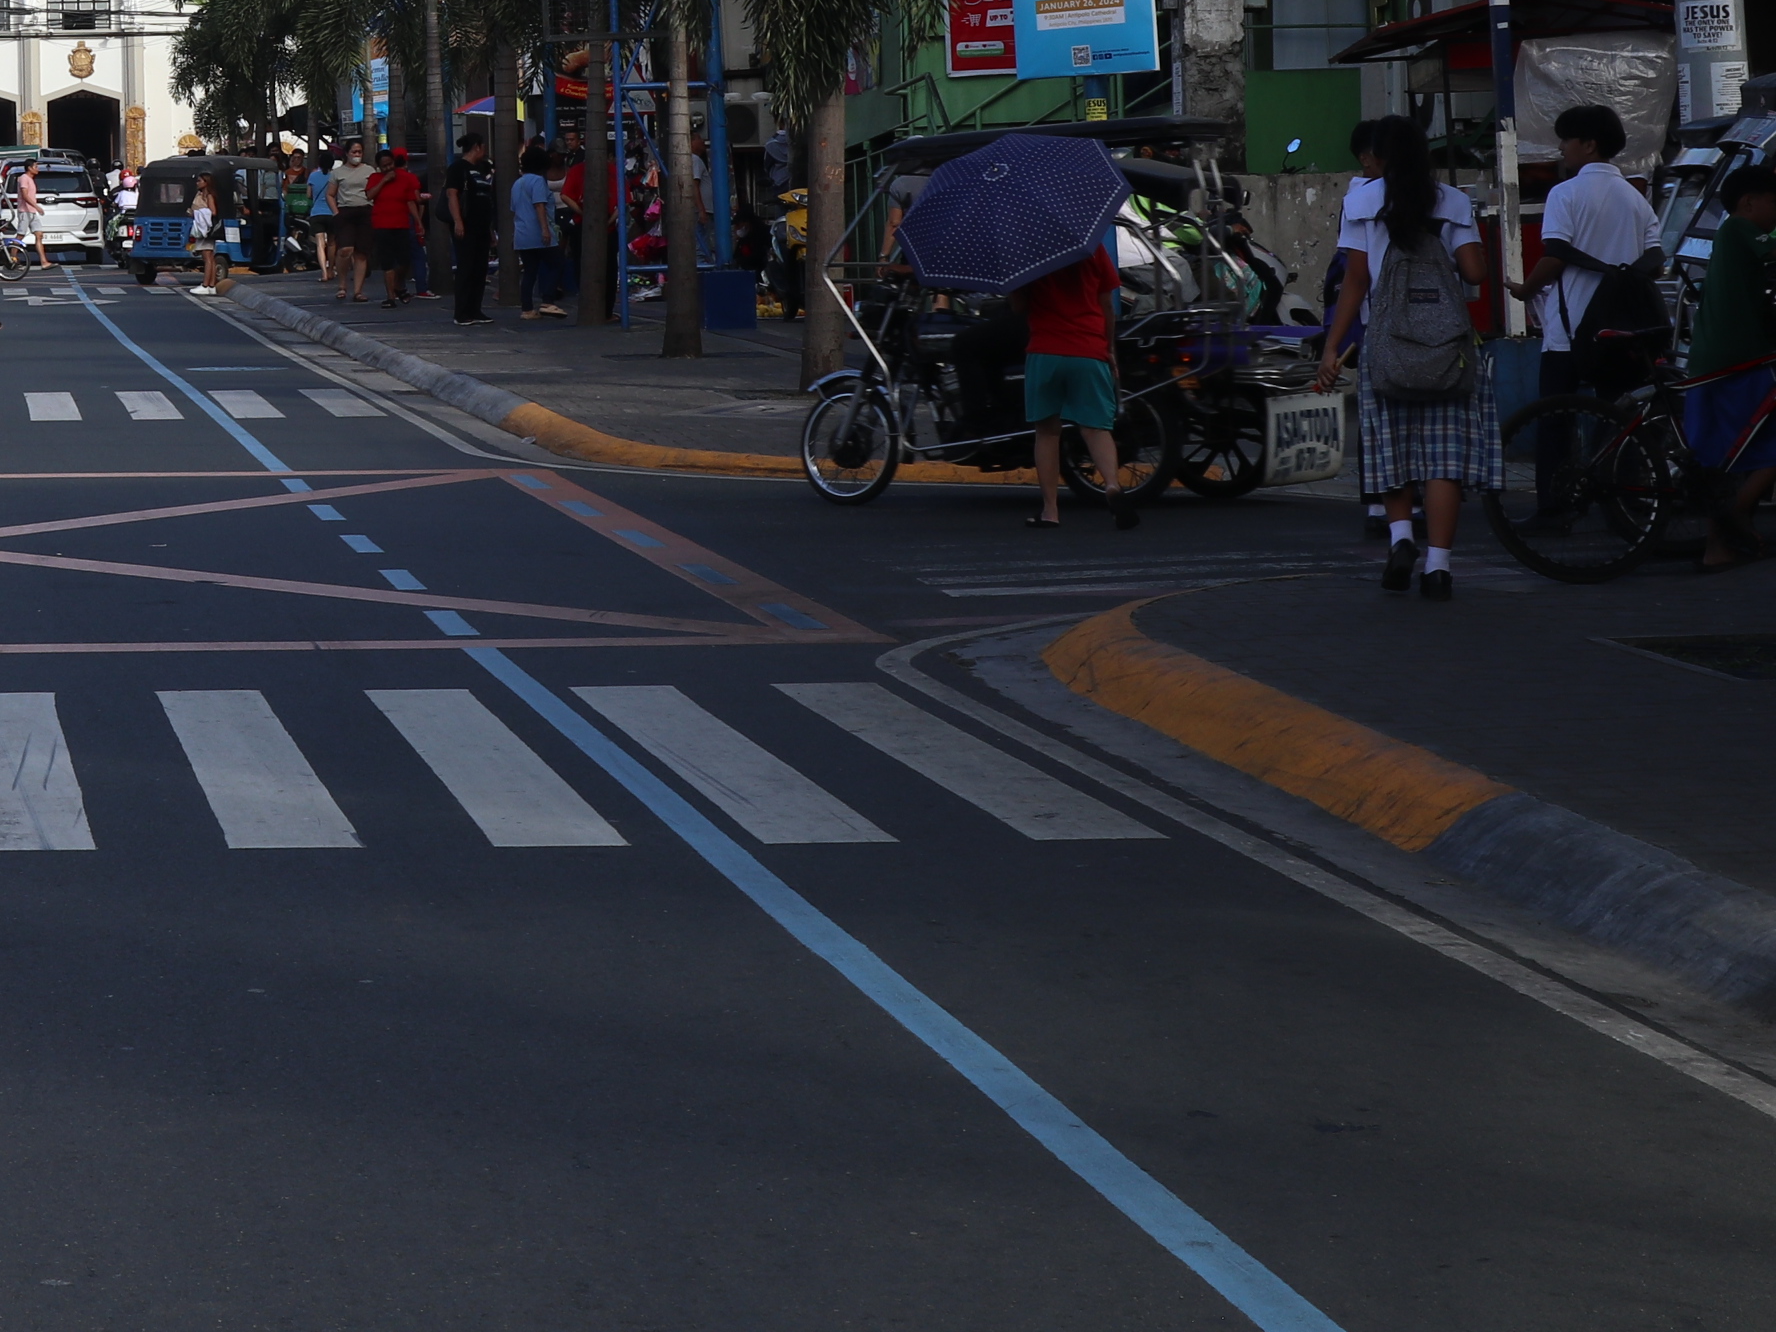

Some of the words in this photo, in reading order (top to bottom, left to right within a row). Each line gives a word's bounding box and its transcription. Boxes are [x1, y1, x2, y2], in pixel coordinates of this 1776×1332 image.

[1039, 1, 1081, 12] JANUARY
[1083, 0, 1096, 7] 26,
[1068, 11, 1090, 19] Antipolo
[1091, 9, 1117, 17] Cathedral
[1684, 5, 1729, 20] JESUS
[1709, 24, 1734, 32] POWER
